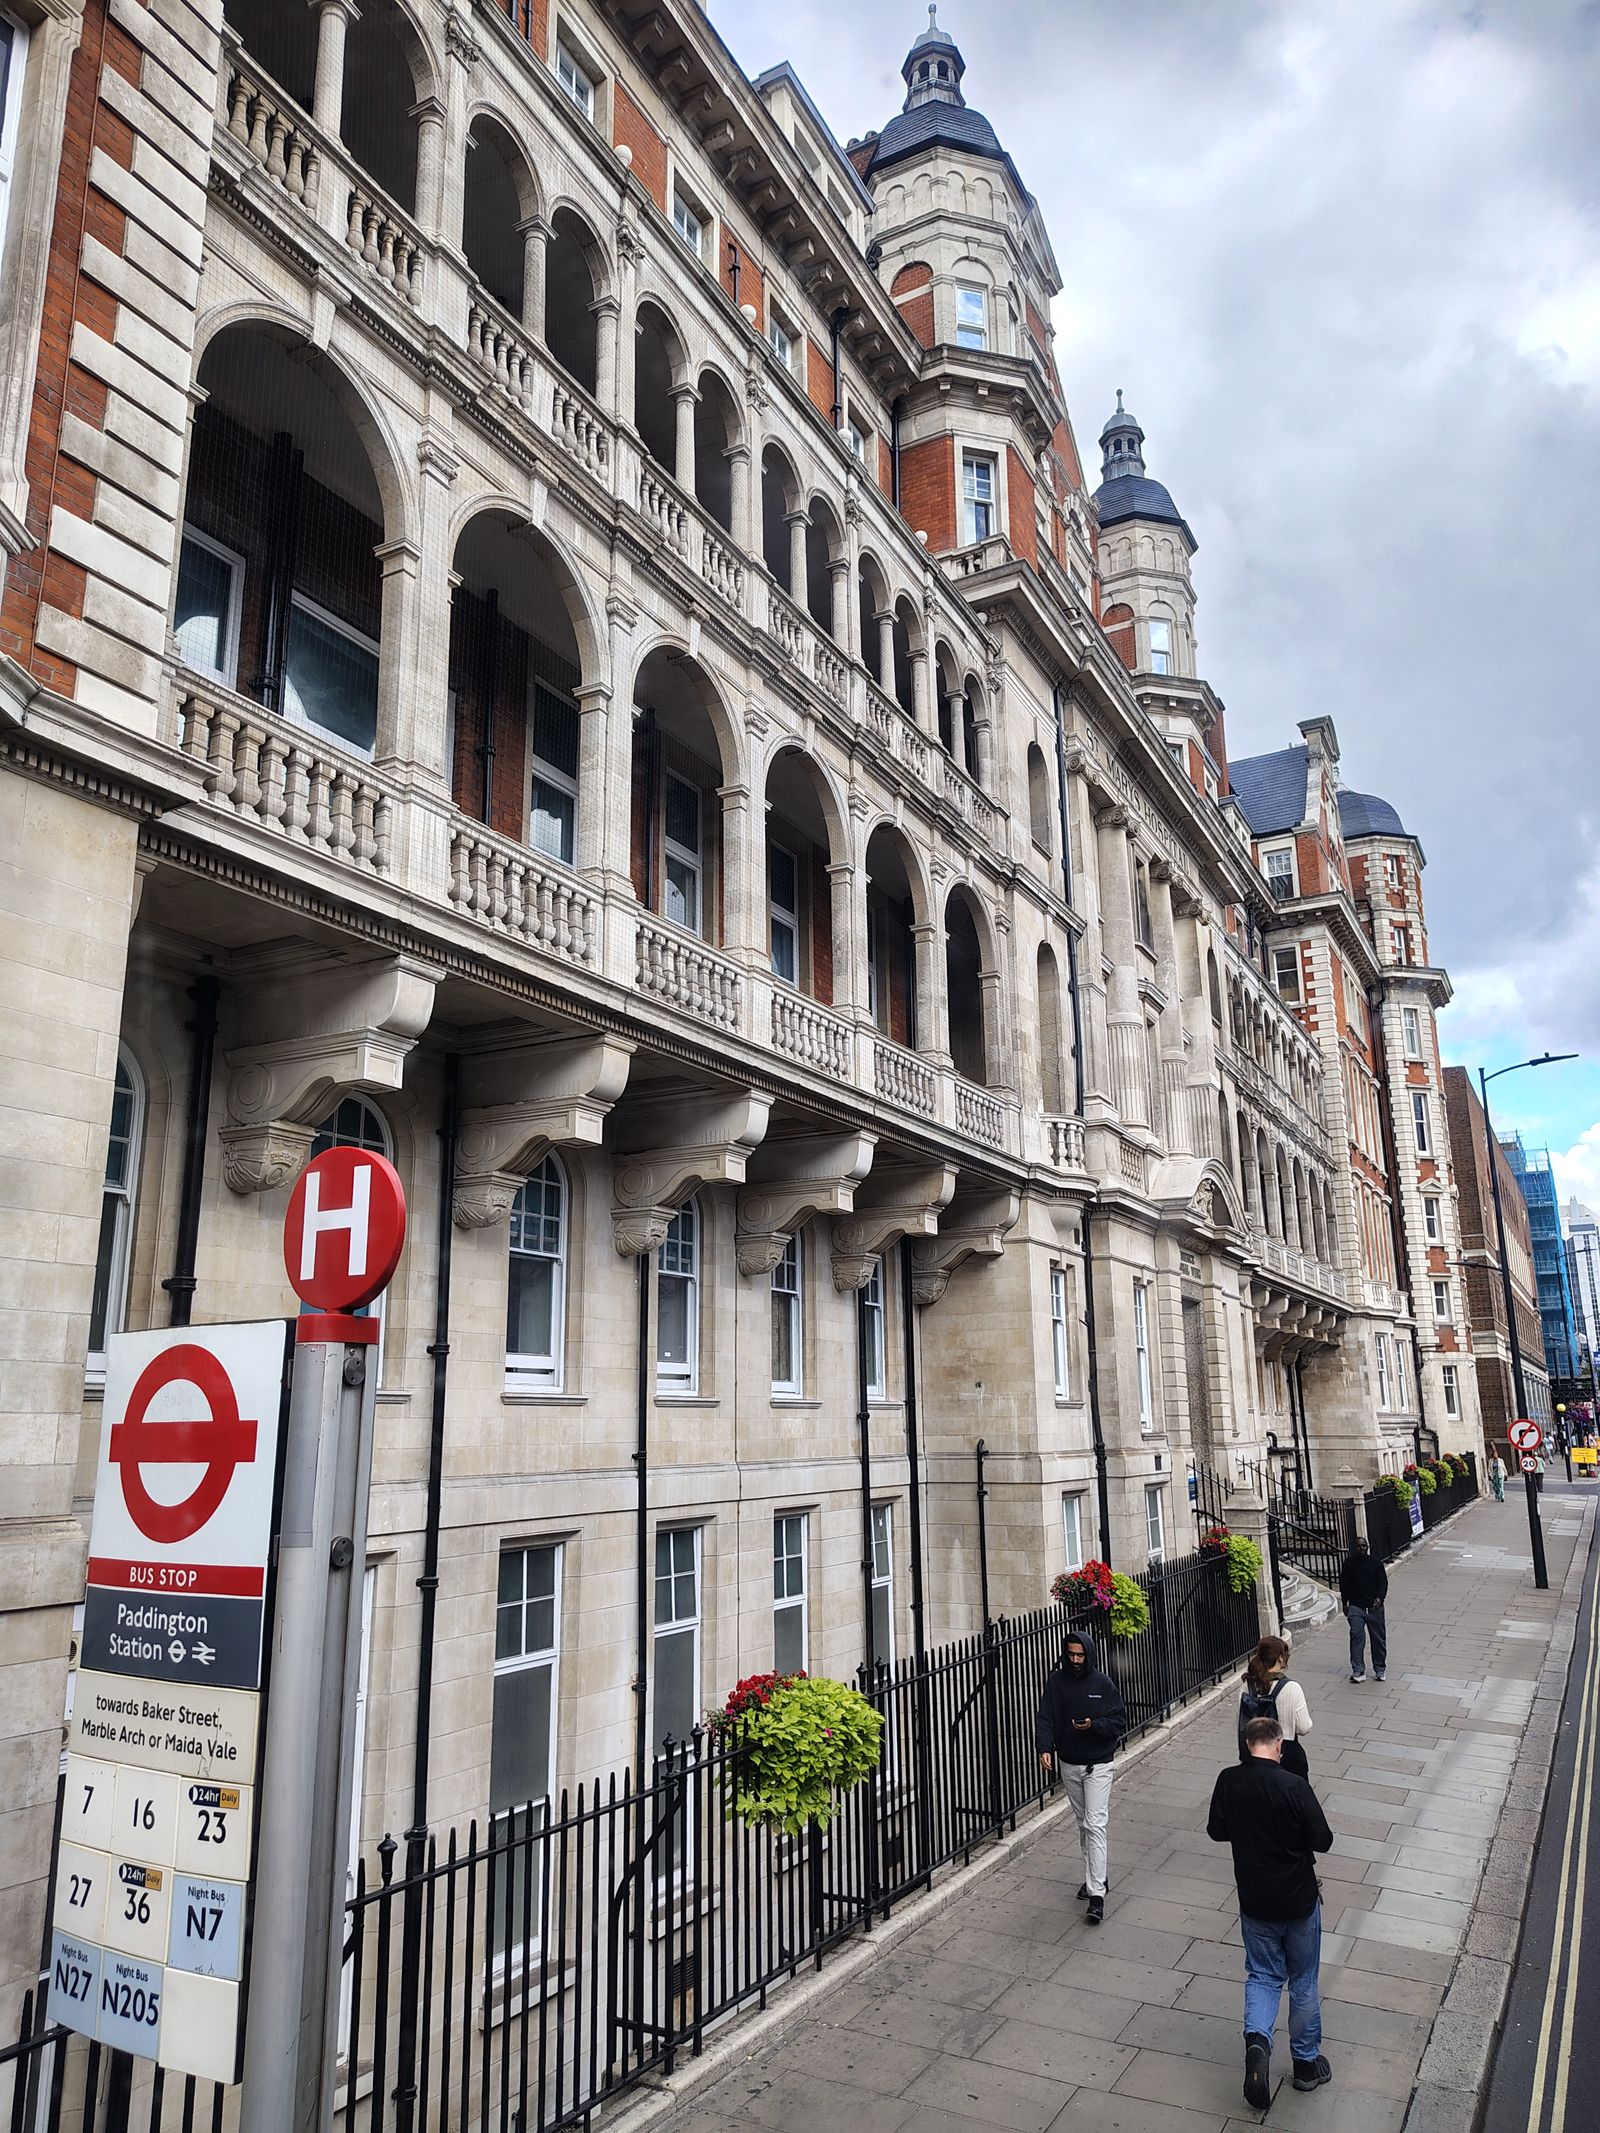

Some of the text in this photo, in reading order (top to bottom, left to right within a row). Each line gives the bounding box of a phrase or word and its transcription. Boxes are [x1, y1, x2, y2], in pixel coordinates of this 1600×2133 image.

[1086, 727, 1099, 754] ST
[1144, 801, 1191, 876] HOSPITAL
[299, 1164, 372, 1281] H
[1523, 1460, 1535, 1468] 20
[129, 1566, 198, 1587] BUS STOP
[117, 1603, 208, 1636] Paddington
[109, 1633, 162, 1661] Station
[96, 1694, 223, 1730] towards Baker Street,
[81, 1718, 237, 1761] Marble Arch or Maida Vale
[82, 1785, 95, 1815] 7
[198, 1787, 238, 1804] 24hr Daily
[132, 1797, 156, 1831] 16
[197, 1810, 227, 1844] 23
[69, 1873, 93, 1909] 27
[126, 1866, 160, 1886] 24hr Daily
[124, 1887, 151, 1925] 36
[187, 1886, 226, 1902] Night Bus
[186, 1905, 223, 1941] N7
[62, 1943, 89, 1963] Night Bus
[54, 1958, 93, 2003] N27
[116, 1963, 149, 1983] Night Bus
[101, 1978, 160, 2027] N205
